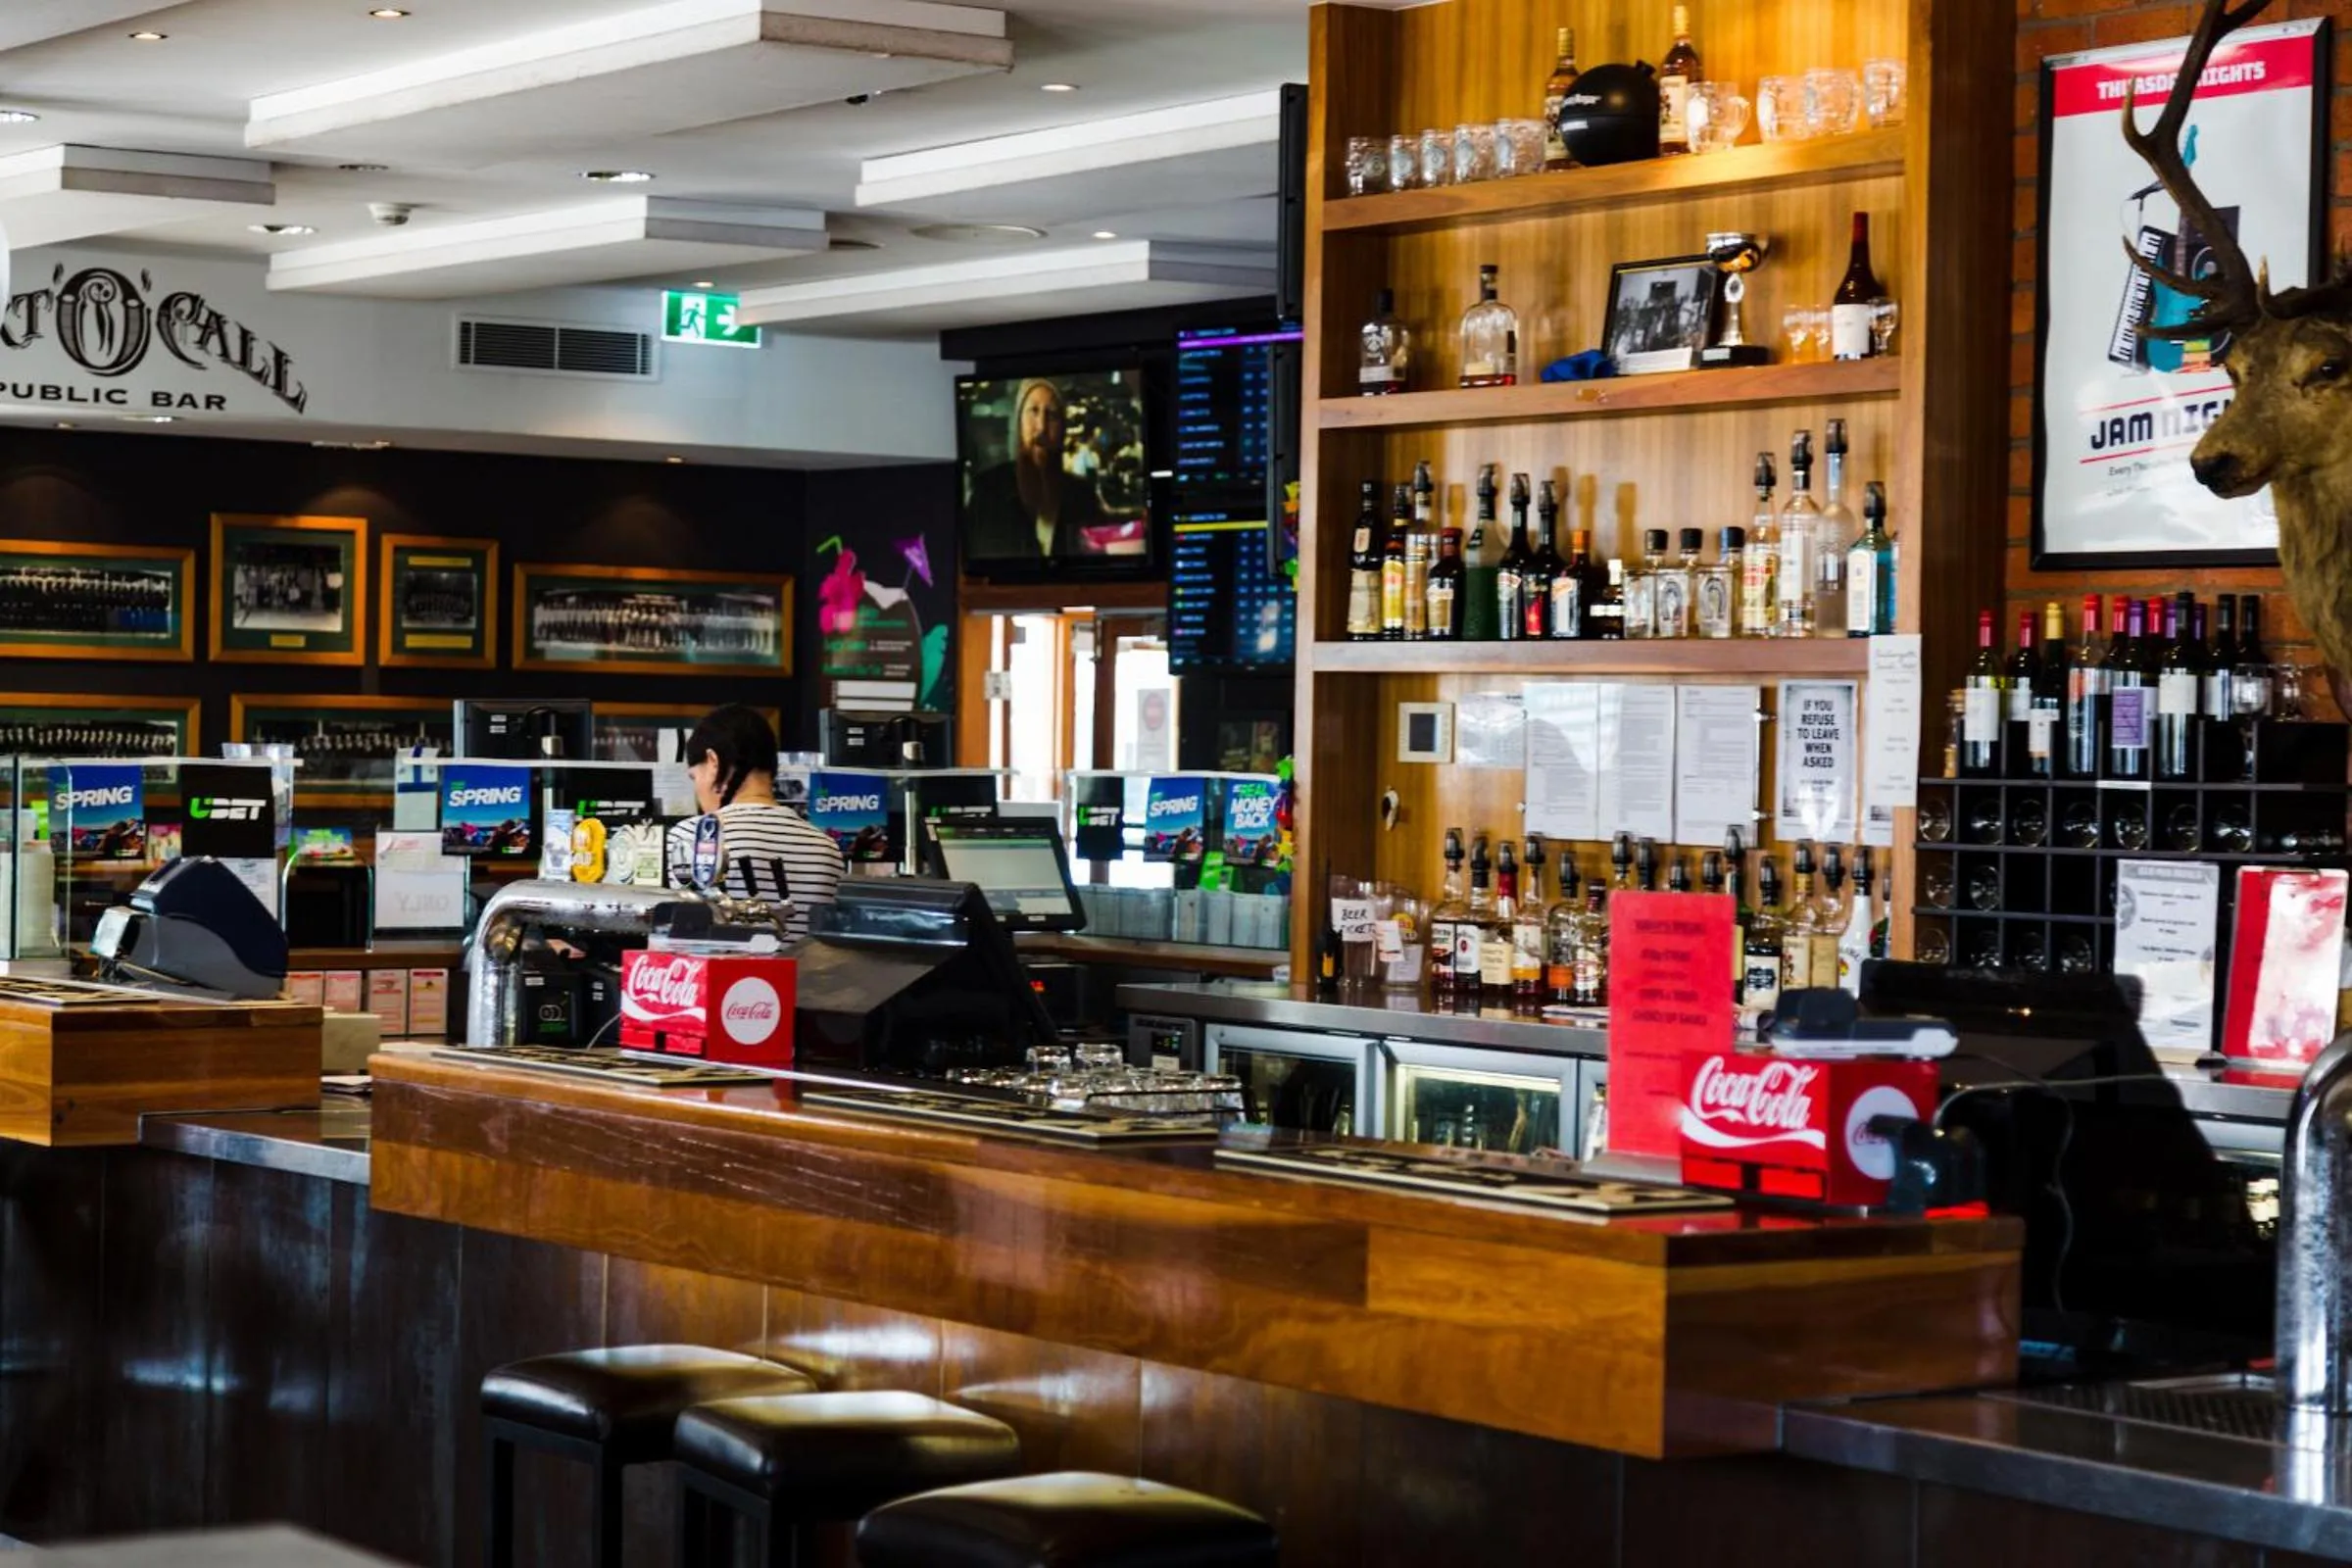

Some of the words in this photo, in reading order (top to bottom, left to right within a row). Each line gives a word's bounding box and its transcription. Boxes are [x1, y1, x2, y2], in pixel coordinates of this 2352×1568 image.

[157, 291, 309, 416] CALL
[151, 390, 227, 411] BAR
[2090, 412, 2154, 451] JAM
[1803, 700, 1812, 710] IF
[1814, 700, 1834, 711] YOU
[1801, 713, 1835, 725] REFUSE
[1797, 728, 1810, 740] TO
[1812, 728, 1839, 741] LEAVE
[1805, 743, 1833, 754] WHEN
[1803, 757, 1835, 768] ASKED
[55, 785, 135, 811] SPRING
[449, 787, 522, 808] SPRING
[815, 794, 880, 813] SPRING
[1151, 797, 1198, 816] SPRING
[1231, 798, 1279, 814] MONEY
[188, 797, 267, 821] UBET
[1235, 812, 1269, 829] BACK
[1342, 908, 1368, 920] BEER
[629, 955, 703, 1006] Coca-Cola
[727, 1002, 773, 1019] Coca-Cola
[1691, 1055, 1819, 1128] Coca-Cola
